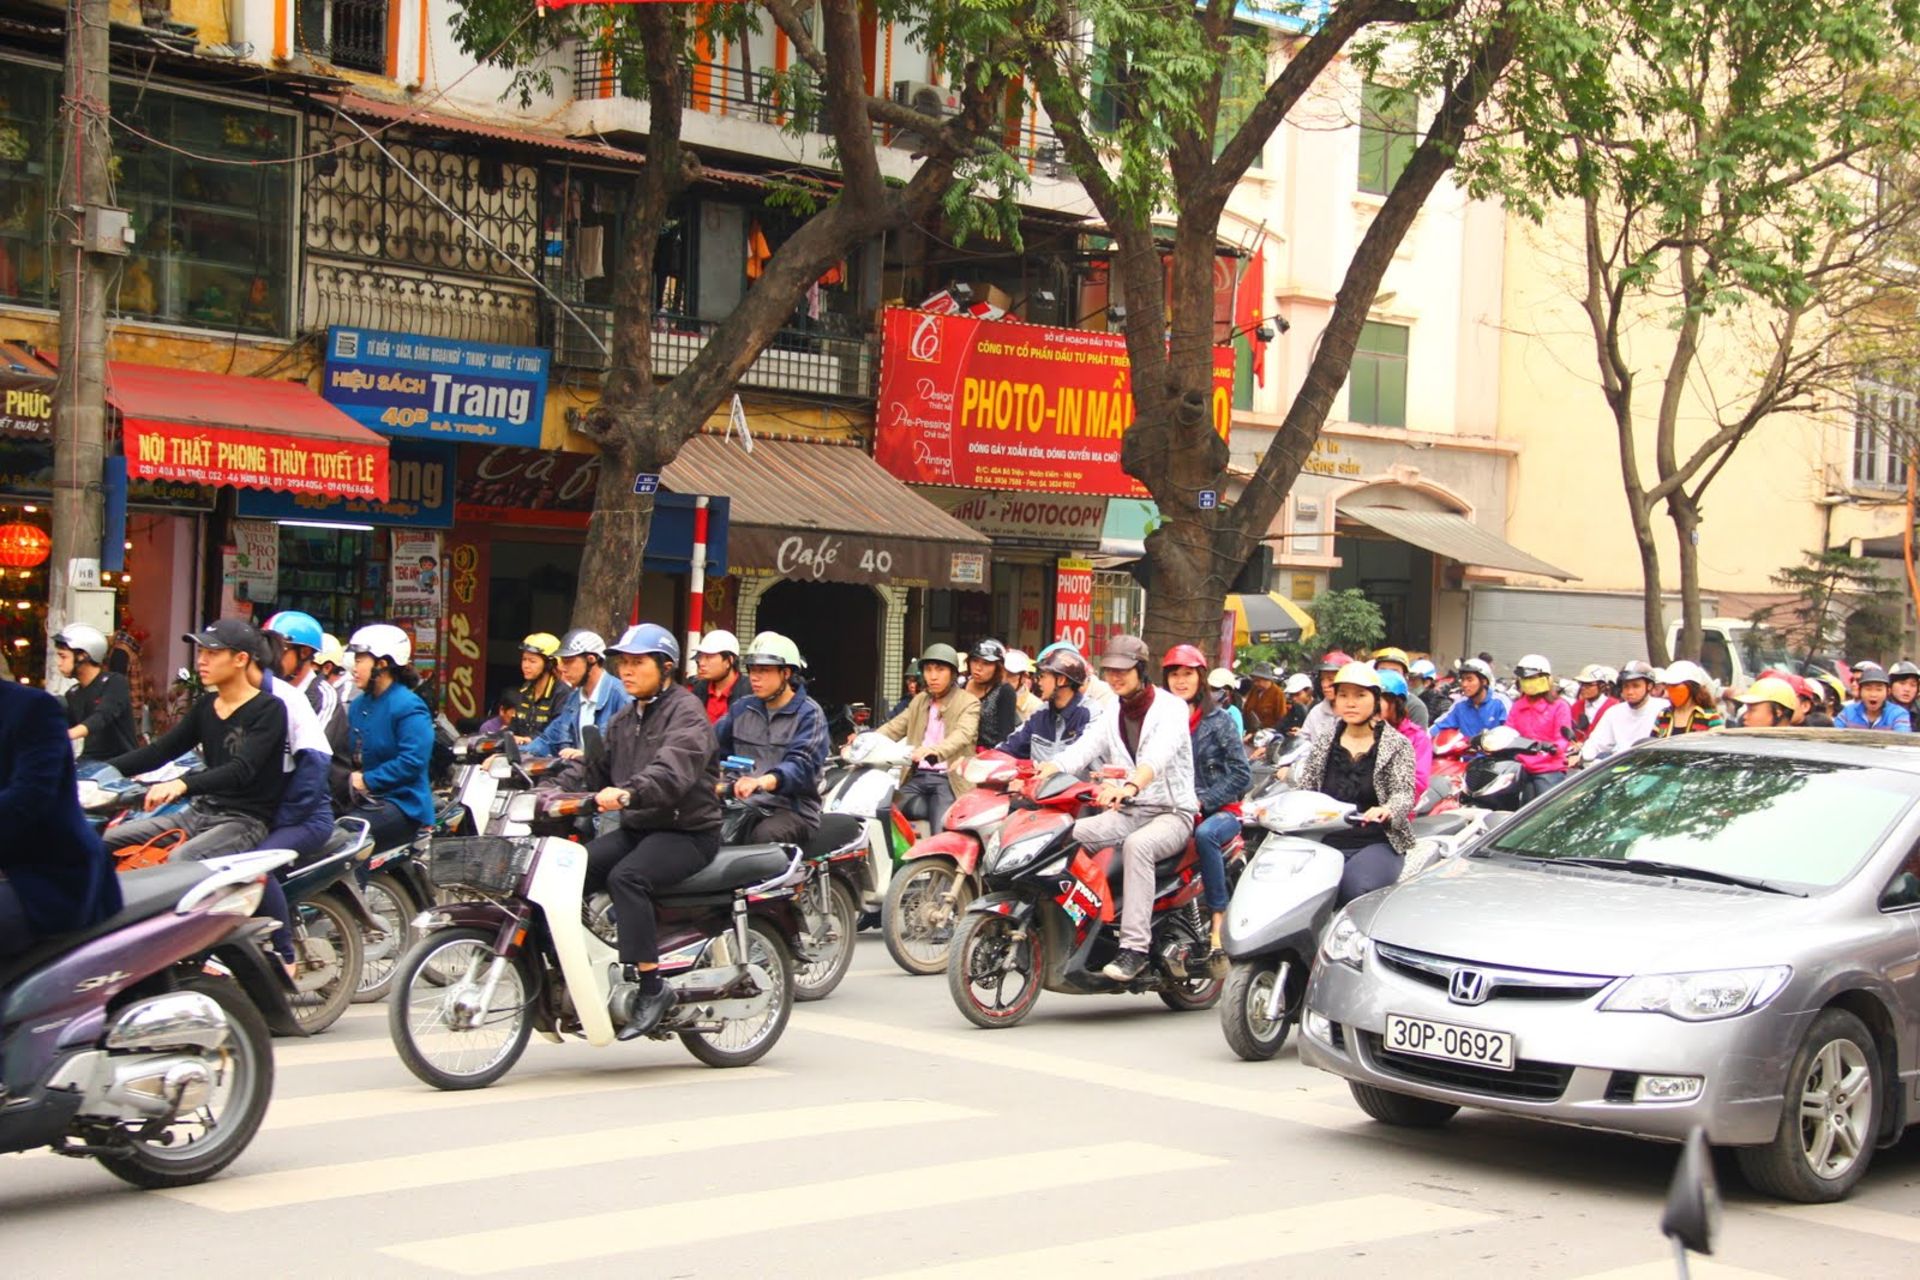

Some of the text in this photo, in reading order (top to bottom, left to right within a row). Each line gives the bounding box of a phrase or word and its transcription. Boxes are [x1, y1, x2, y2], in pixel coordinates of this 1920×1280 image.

[1004, 345, 1015, 356] TY
[332, 369, 531, 425] HIỆU SÁCH Trang
[916, 378, 953, 402] Design
[6, 389, 52, 419] PHÚC
[381, 406, 497, 436] 40B BÀ TRIỆU
[138, 432, 375, 482] NỘI THẤT PHONG THỦY TUYẾT LÊ
[913, 440, 952, 468] Printing
[1000, 501, 1103, 528] PHOTOCOPY
[247, 542, 276, 557] PRO
[776, 535, 892, 578] Café 40
[1057, 574, 1092, 594] PHOTO
[1057, 602, 1067, 621] IN
